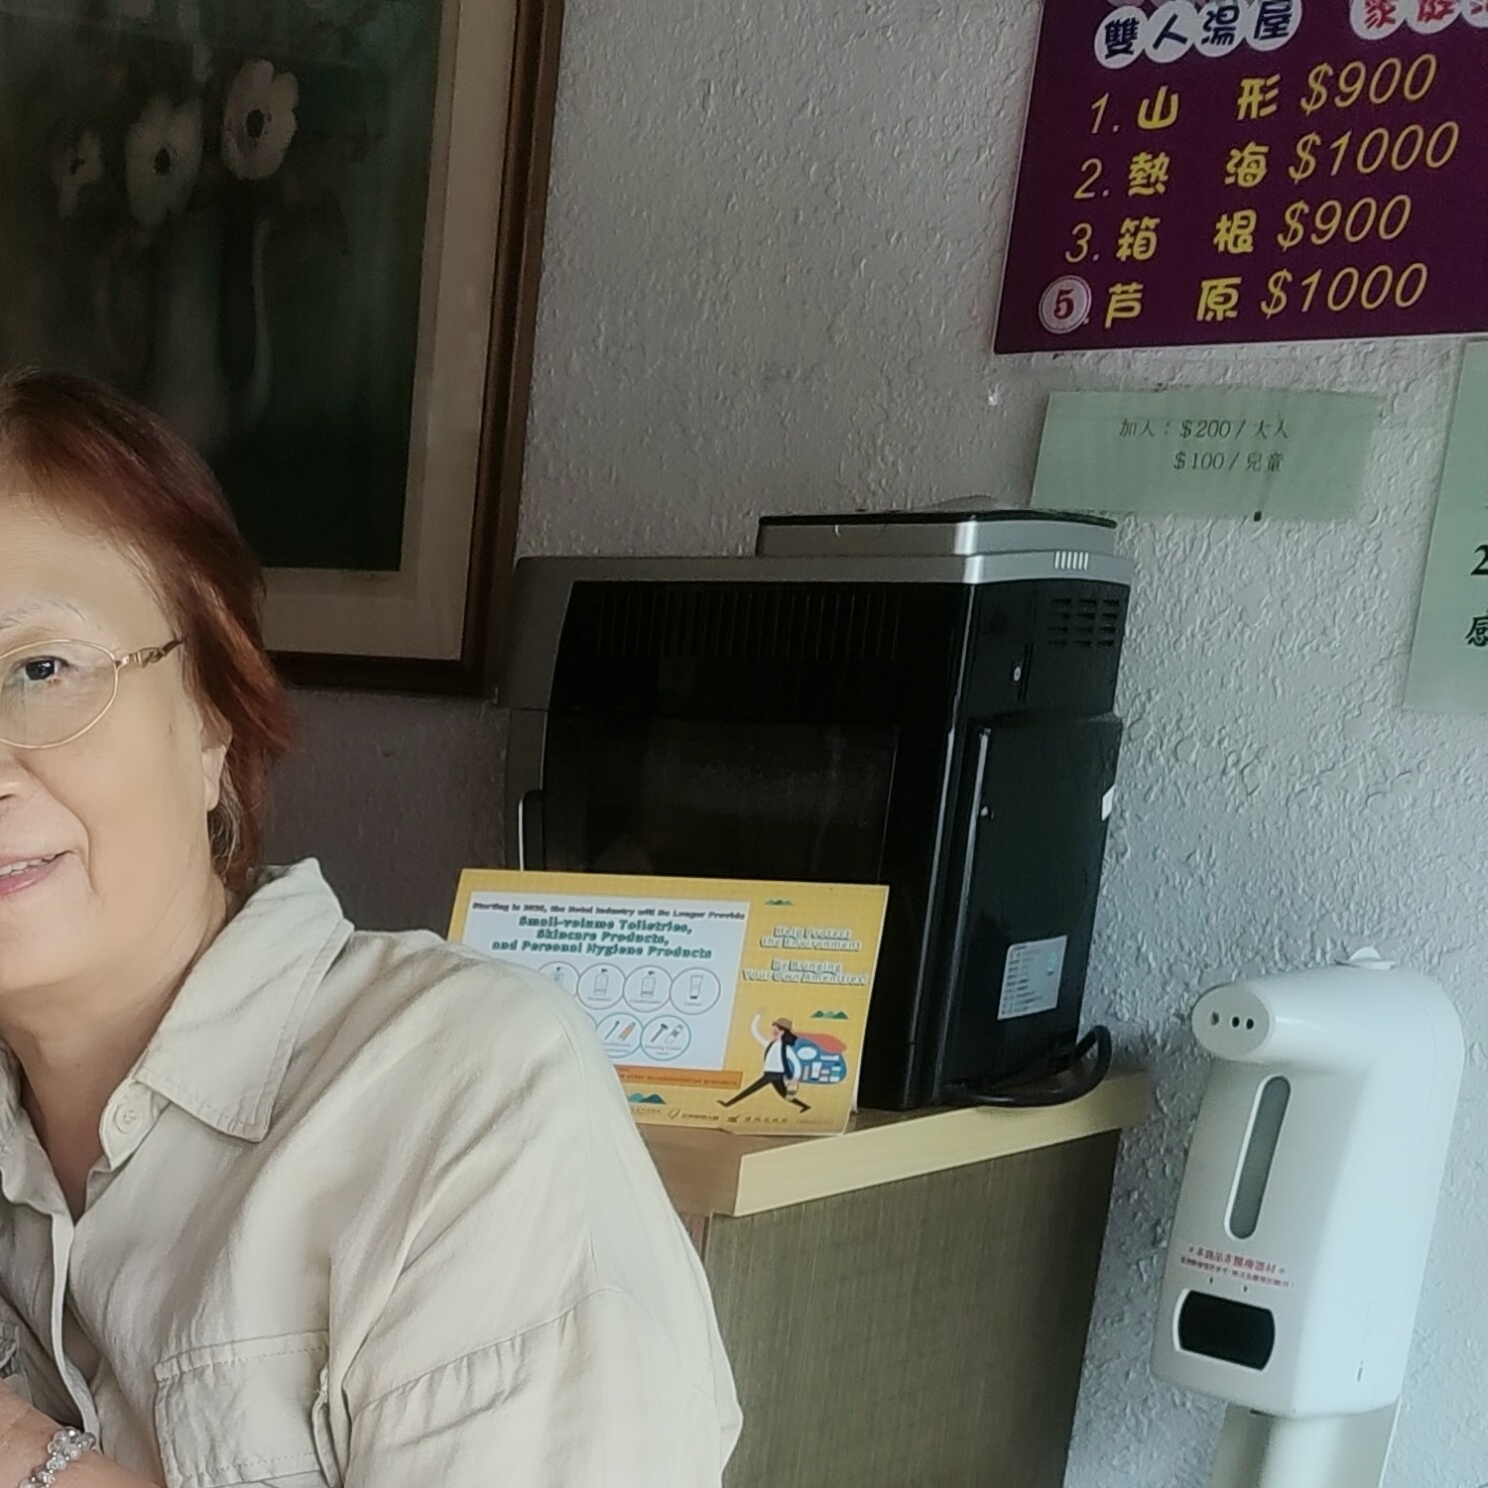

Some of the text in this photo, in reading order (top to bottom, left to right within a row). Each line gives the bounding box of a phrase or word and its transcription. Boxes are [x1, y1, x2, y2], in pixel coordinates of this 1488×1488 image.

[1302, 53, 1438, 117] $900
[1289, 121, 1460, 183] $1000
[1277, 194, 1412, 251] $900
[1260, 262, 1428, 319] $1000
[492, 940, 712, 959] and Personal Hygiene Products
[536, 929, 670, 946] Skincare Products,
[619, 919, 693, 935] Toiletries,
